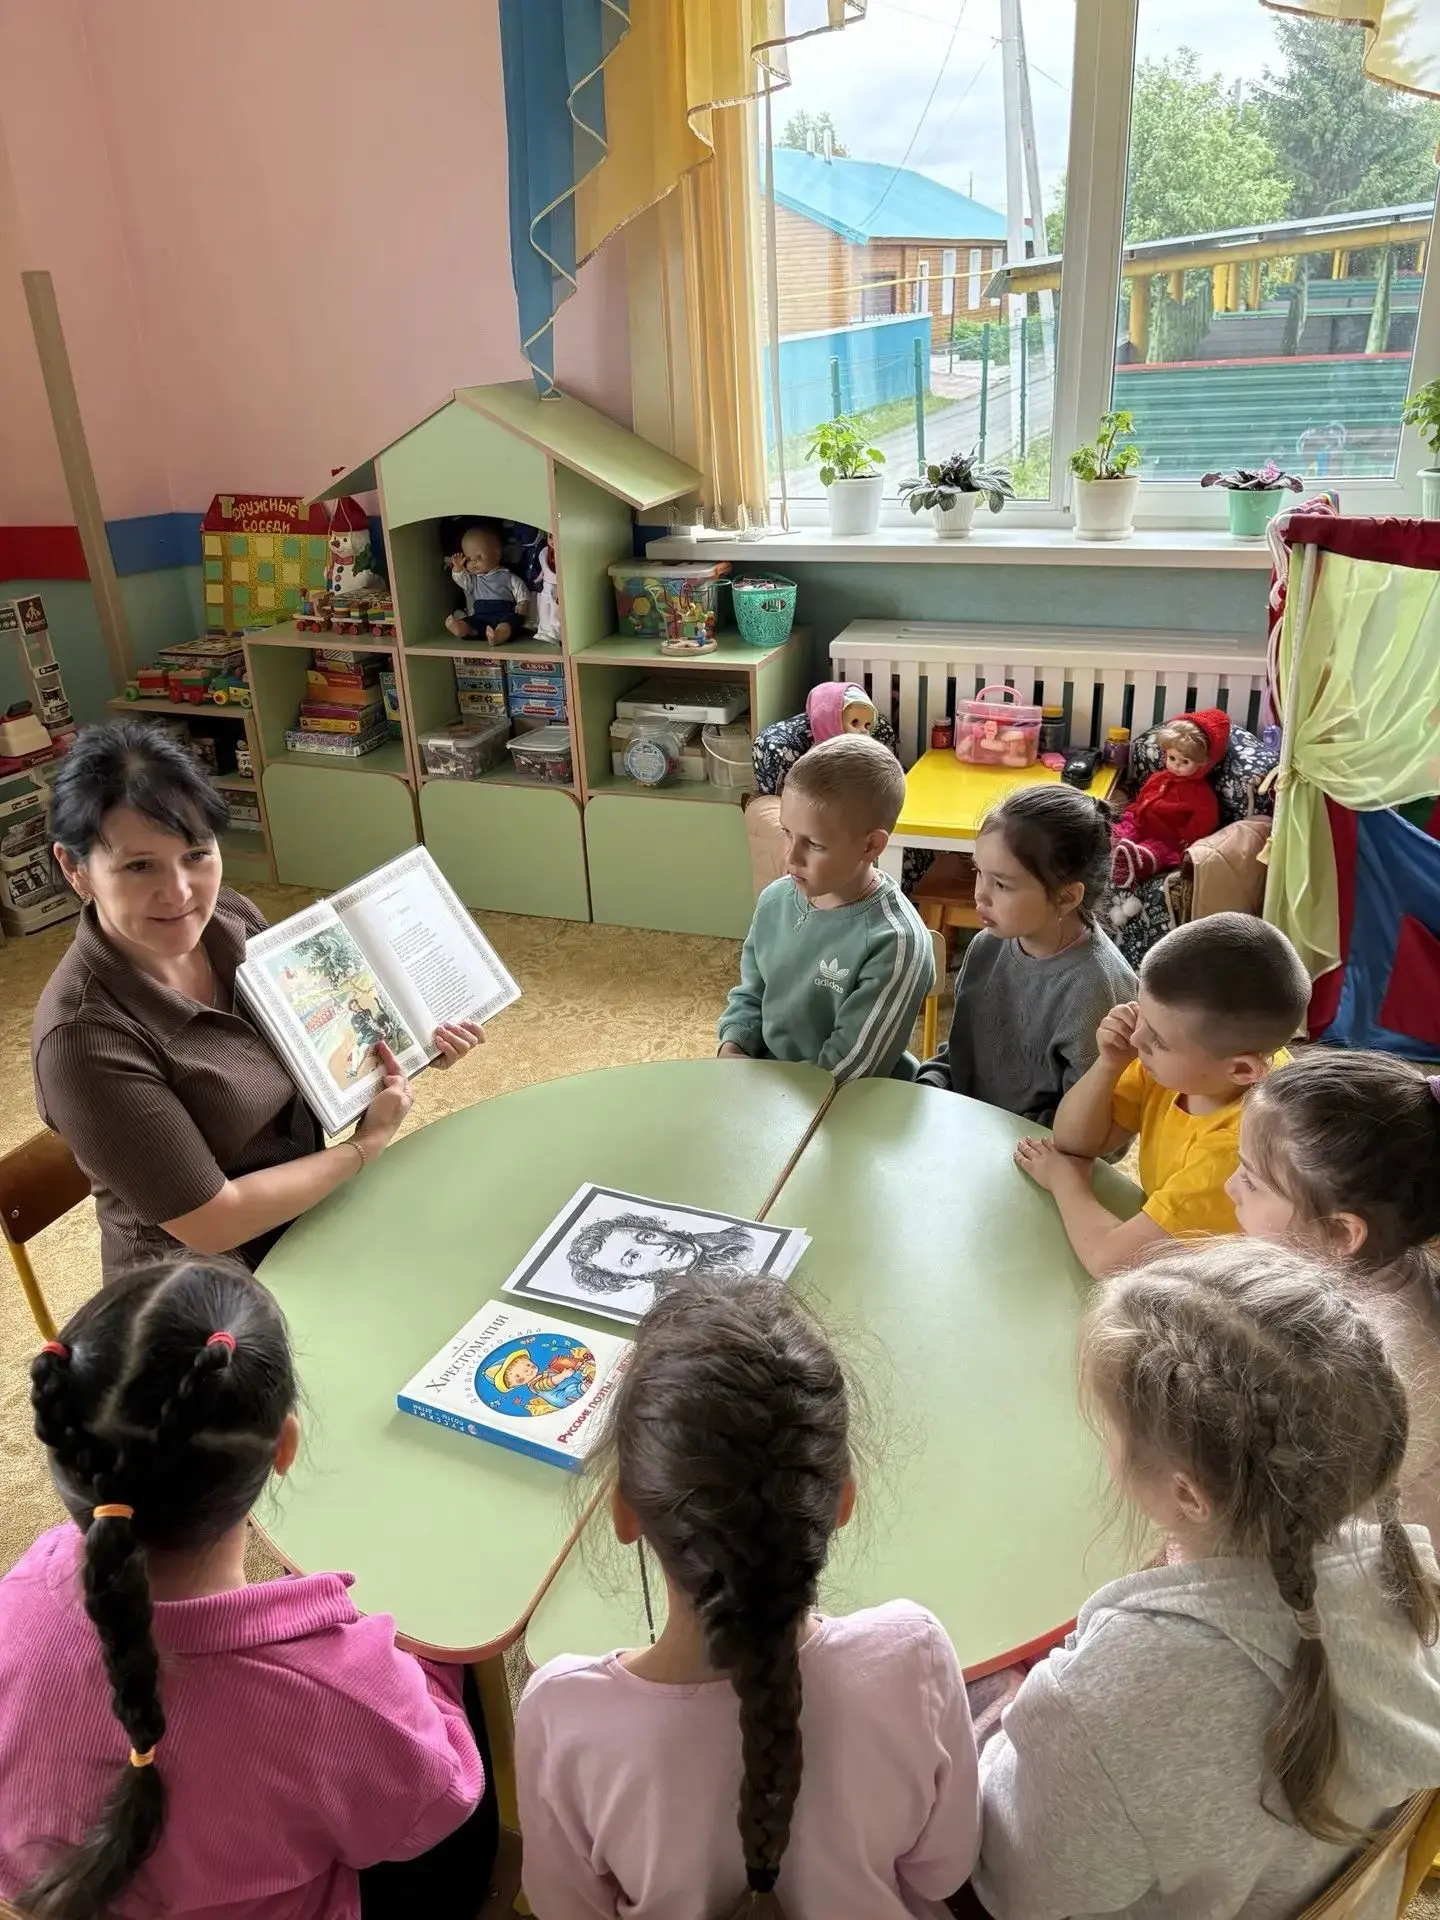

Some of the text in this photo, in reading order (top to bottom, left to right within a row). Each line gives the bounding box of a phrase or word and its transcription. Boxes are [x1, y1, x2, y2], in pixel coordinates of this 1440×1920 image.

[232, 498, 299, 521] ДРУЖНЫЕ
[242, 519, 291, 534] СОСЕДИ
[814, 978, 844, 994] adidas
